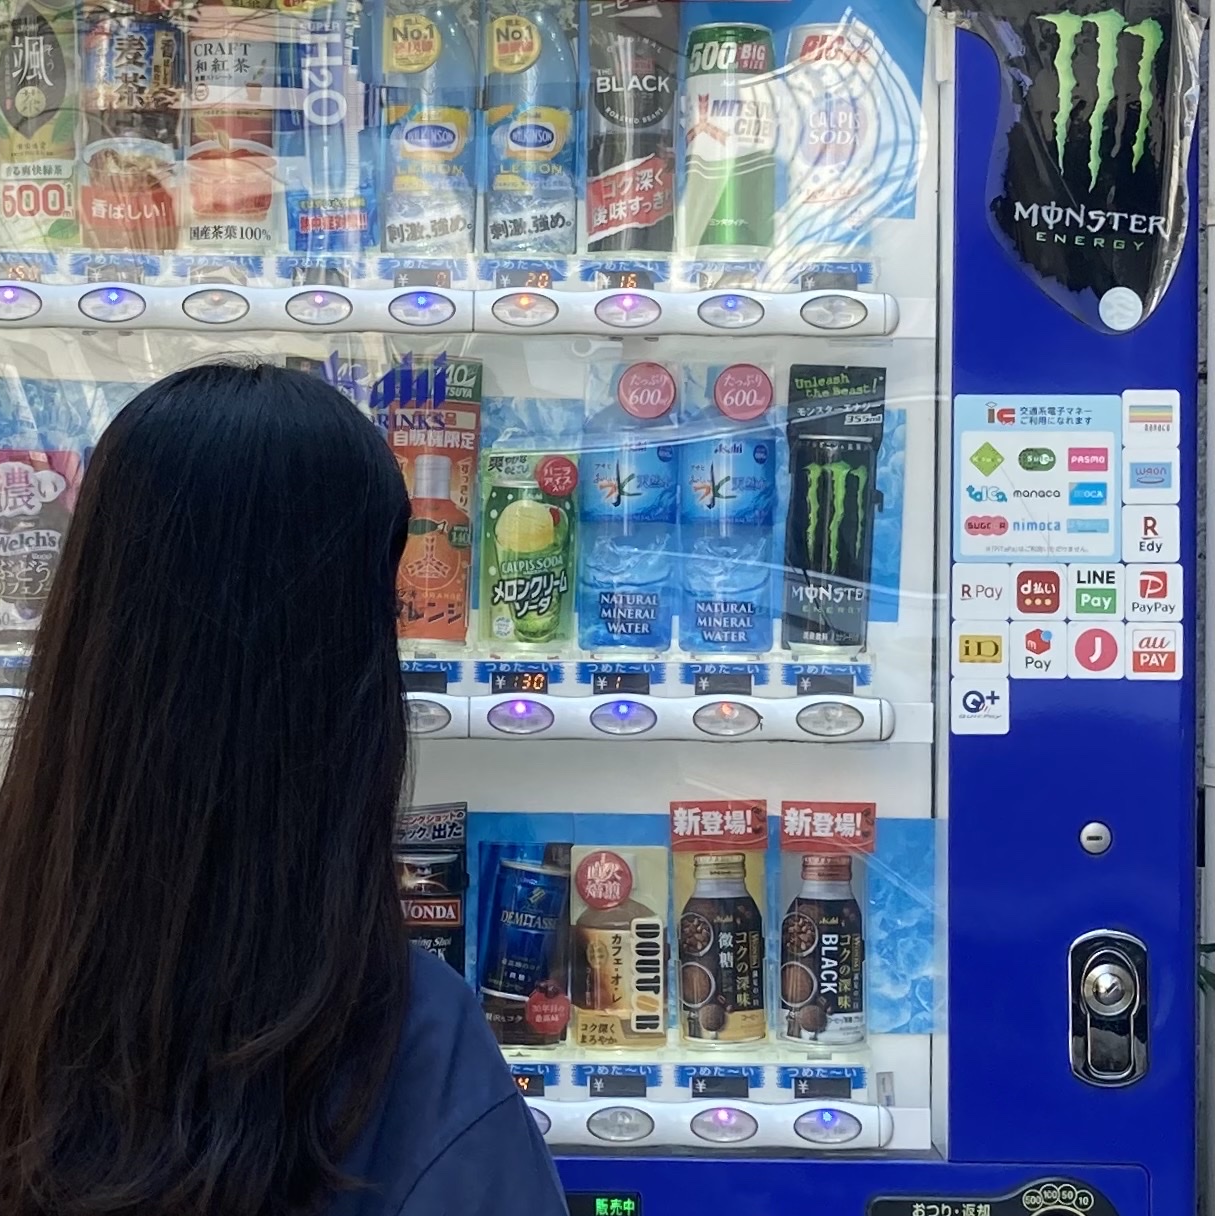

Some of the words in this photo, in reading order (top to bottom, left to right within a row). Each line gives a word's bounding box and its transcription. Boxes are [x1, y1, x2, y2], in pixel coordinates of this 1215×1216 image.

[194, 42, 252, 57] CRAFT
[742, 45, 766, 59] BIG
[114, 35, 147, 107] 麦茶
[195, 58, 251, 74] 和紅茶
[597, 77, 670, 93] BLACK
[603, 168, 663, 199] コク深く
[189, 225, 271, 241] 国産茶葉100%
[1036, 232, 1145, 251] ENERGY
[795, 373, 850, 389] Unleash
[806, 390, 829, 398] the
[1020, 407, 1092, 415] 交通系電子マネー
[1020, 416, 1092, 425] ご利用になれます
[393, 430, 475, 449] 自販機限定
[1071, 456, 1105, 464] PASMO
[1013, 489, 1061, 498] manaca
[1013, 518, 1061, 531] nimoca
[1139, 541, 1163, 552] Edy
[501, 560, 533, 574] CALPIS
[536, 557, 563, 569] SODA
[1077, 570, 1115, 584] LINE
[493, 573, 568, 604] メロンクリーム
[976, 585, 1003, 600] Pay
[1021, 580, 1056, 594] d払い
[515, 596, 551, 617] ソーダ
[599, 593, 659, 606] NATURAL
[1081, 594, 1112, 609] Pay
[600, 607, 657, 620] MINERAL
[696, 601, 754, 614] NATURAL
[1132, 602, 1176, 615] PayPay
[607, 621, 650, 635] WATER
[696, 616, 753, 628] MINERAL
[703, 629, 747, 643] WATER
[1139, 635, 1170, 649] au
[963, 639, 999, 657] iD
[1025, 657, 1051, 671] Pay
[1140, 653, 1169, 667] PAY
[674, 807, 752, 837] 新登場!
[784, 807, 862, 838] 新登場!
[718, 932, 734, 968] 微糖
[735, 932, 751, 1007] コクの深味
[820, 934, 839, 994] BLACK
[839, 934, 852, 1009] コクの深味
[1025, 1195, 1041, 1205] 500
[1043, 1190, 1057, 1200] 100
[1061, 1190, 1074, 1200] 50
[1079, 1196, 1089, 1206] 10
[596, 1198, 635, 1216] 販売中
